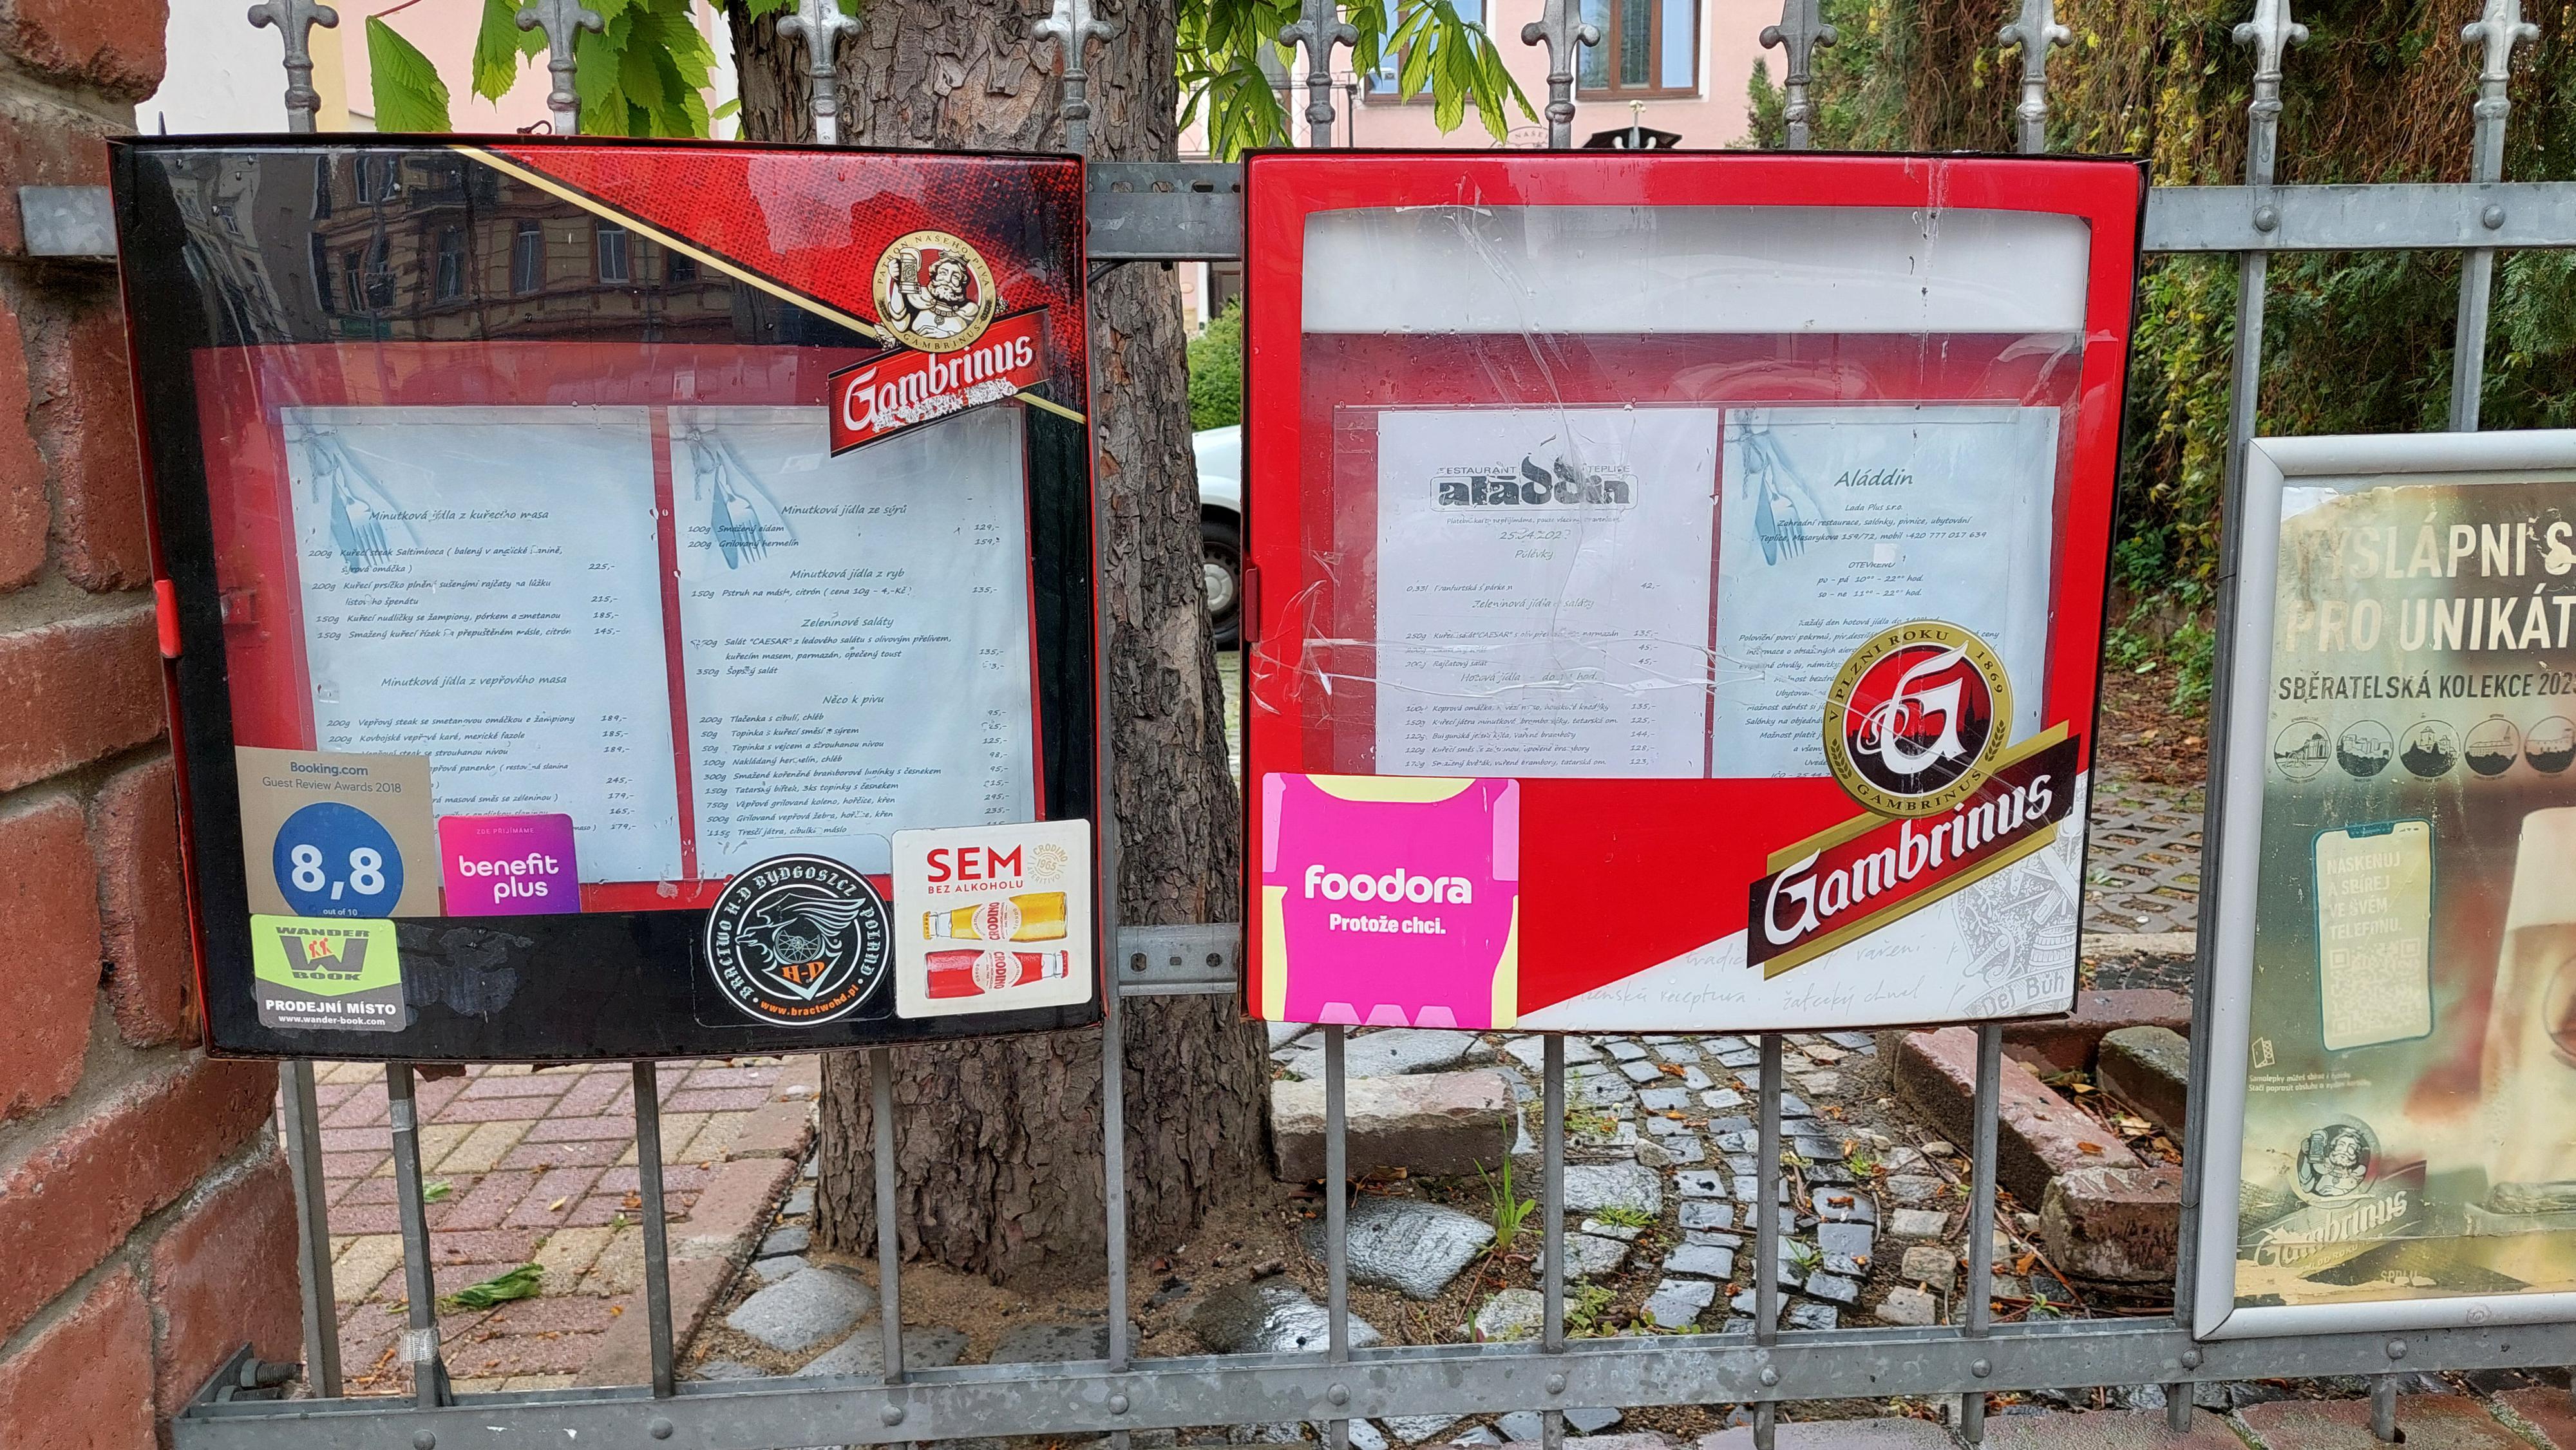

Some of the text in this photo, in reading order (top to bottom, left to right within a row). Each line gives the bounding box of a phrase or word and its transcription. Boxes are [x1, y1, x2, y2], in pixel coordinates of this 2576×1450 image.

[877, 234, 990, 287] PATRON NAŠEHO PIVA
[904, 324, 981, 350] GAMBRINUS
[844, 336, 1032, 431] Gambrinus
[1834, 468, 1913, 487] Aláddin
[366, 509, 429, 523] Minutková
[520, 512, 549, 522] masa
[780, 505, 839, 517] Minutková
[838, 505, 865, 516] jídla
[883, 505, 907, 516] sýrů
[688, 526, 711, 534] 100g
[717, 524, 756, 534] Smažený
[757, 523, 784, 532] eidam
[1777, 516, 1817, 529] Zahradní
[1818, 516, 1861, 526] restaurace,
[1931, 516, 1973, 526] ubytování
[1880, 531, 1903, 540] mobil
[688, 541, 712, 550] 200g
[719, 538, 760, 549] Grilovaný
[760, 536, 799, 549] hermelín
[790, 569, 848, 578] Minutková
[847, 569, 873, 580] jídla
[886, 568, 905, 580] ryb
[316, 616, 339, 625] 150g
[377, 614, 413, 623] nudličky
[427, 613, 472, 623] žampiony,
[474, 612, 508, 622] pórkem
[800, 615, 894, 628] Zeleninové saláty
[1870, 617, 1891, 629] jídla
[2286, 599, 2382, 652] PRO
[762, 652, 793, 662] masem,
[795, 651, 841, 661] parmazán,
[381, 676, 440, 686] Minutková
[439, 675, 466, 688] jídla
[1829, 629, 2004, 723] V PLZNI ROKU 1869
[2280, 670, 2432, 701] SBĚRATELSKÁ
[2439, 673, 2534, 699] KOLEKCE
[822, 694, 884, 706] Něco k pivu
[699, 717, 723, 725] 200g
[775, 713, 799, 722] cibulí,
[1745, 716, 1773, 726] Salónky
[328, 736, 352, 744] 200g
[359, 733, 401, 743] Kovbojské
[464, 731, 499, 740] mexické
[1792, 731, 1816, 740] platit
[290, 762, 368, 776] Booking.com
[262, 777, 401, 793] Guest Review Awards 2018
[1857, 769, 1983, 811] GAMBRINUS
[770, 798, 810, 809] grilované
[877, 796, 895, 804] křen
[1034, 843, 1068, 862] CRODINO
[1764, 774, 2052, 945] Gambrinus
[459, 852, 559, 877] benefit
[927, 843, 1021, 882] SEM
[1037, 860, 1057, 870] 1965
[2327, 851, 2400, 875] NASKENUJ
[290, 844, 385, 900] 8,8
[493, 876, 549, 903] plus
[724, 887, 752, 915] H-D
[753, 866, 858, 896] BYDGOSZCZ
[955, 880, 1023, 892] ALKOHOLU
[1305, 864, 1472, 904] foodora
[2328, 883, 2338, 896] A
[323, 907, 337, 916] out
[338, 907, 345, 916] of
[2329, 904, 2345, 918] VE
[988, 901, 1001, 941] CRODINO
[1329, 914, 1446, 934] Protože chci.
[276, 927, 370, 937] WANDER
[292, 972, 361, 981] BOOK
[781, 961, 825, 984] H-D
[994, 951, 1007, 989] CRODINO
[265, 999, 397, 1015] PRODEJNÍ MÍSTO
[760, 984, 858, 1016] www.bractwohd.pl
[278, 1015, 385, 1026] www.wander-book.com
[2266, 1084, 2293, 1093] poprosit
